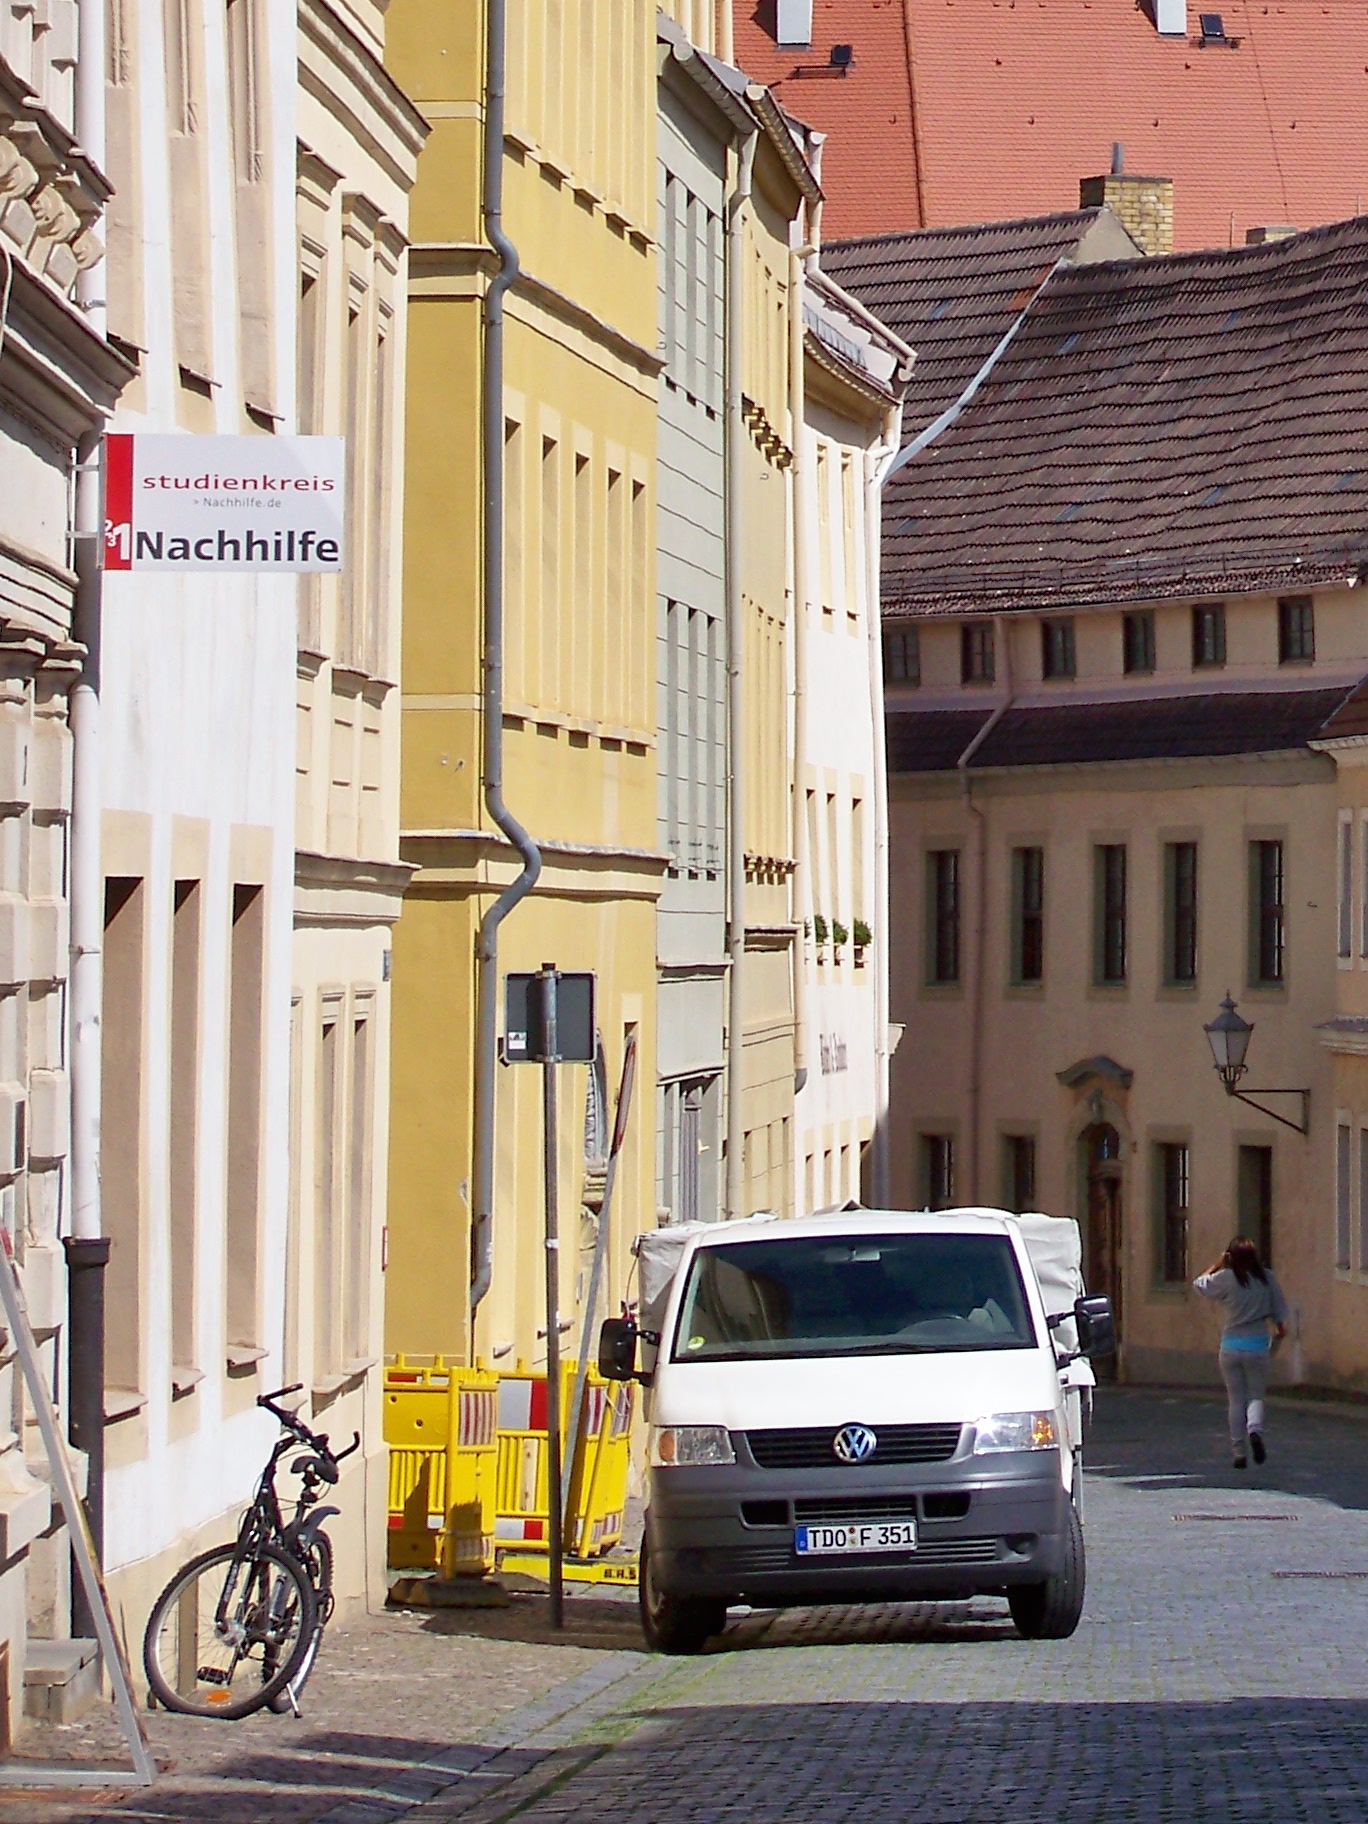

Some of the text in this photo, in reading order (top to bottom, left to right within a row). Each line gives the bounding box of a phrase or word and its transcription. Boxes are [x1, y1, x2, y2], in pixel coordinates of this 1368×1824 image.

[143, 474, 334, 491] studienkreis
[203, 497, 282, 508] Nachhilfe.de
[136, 530, 339, 562] Nachhilfe
[808, 1528, 847, 1548] TDO
[859, 1527, 873, 1546] F
[877, 1525, 914, 1546] 351
